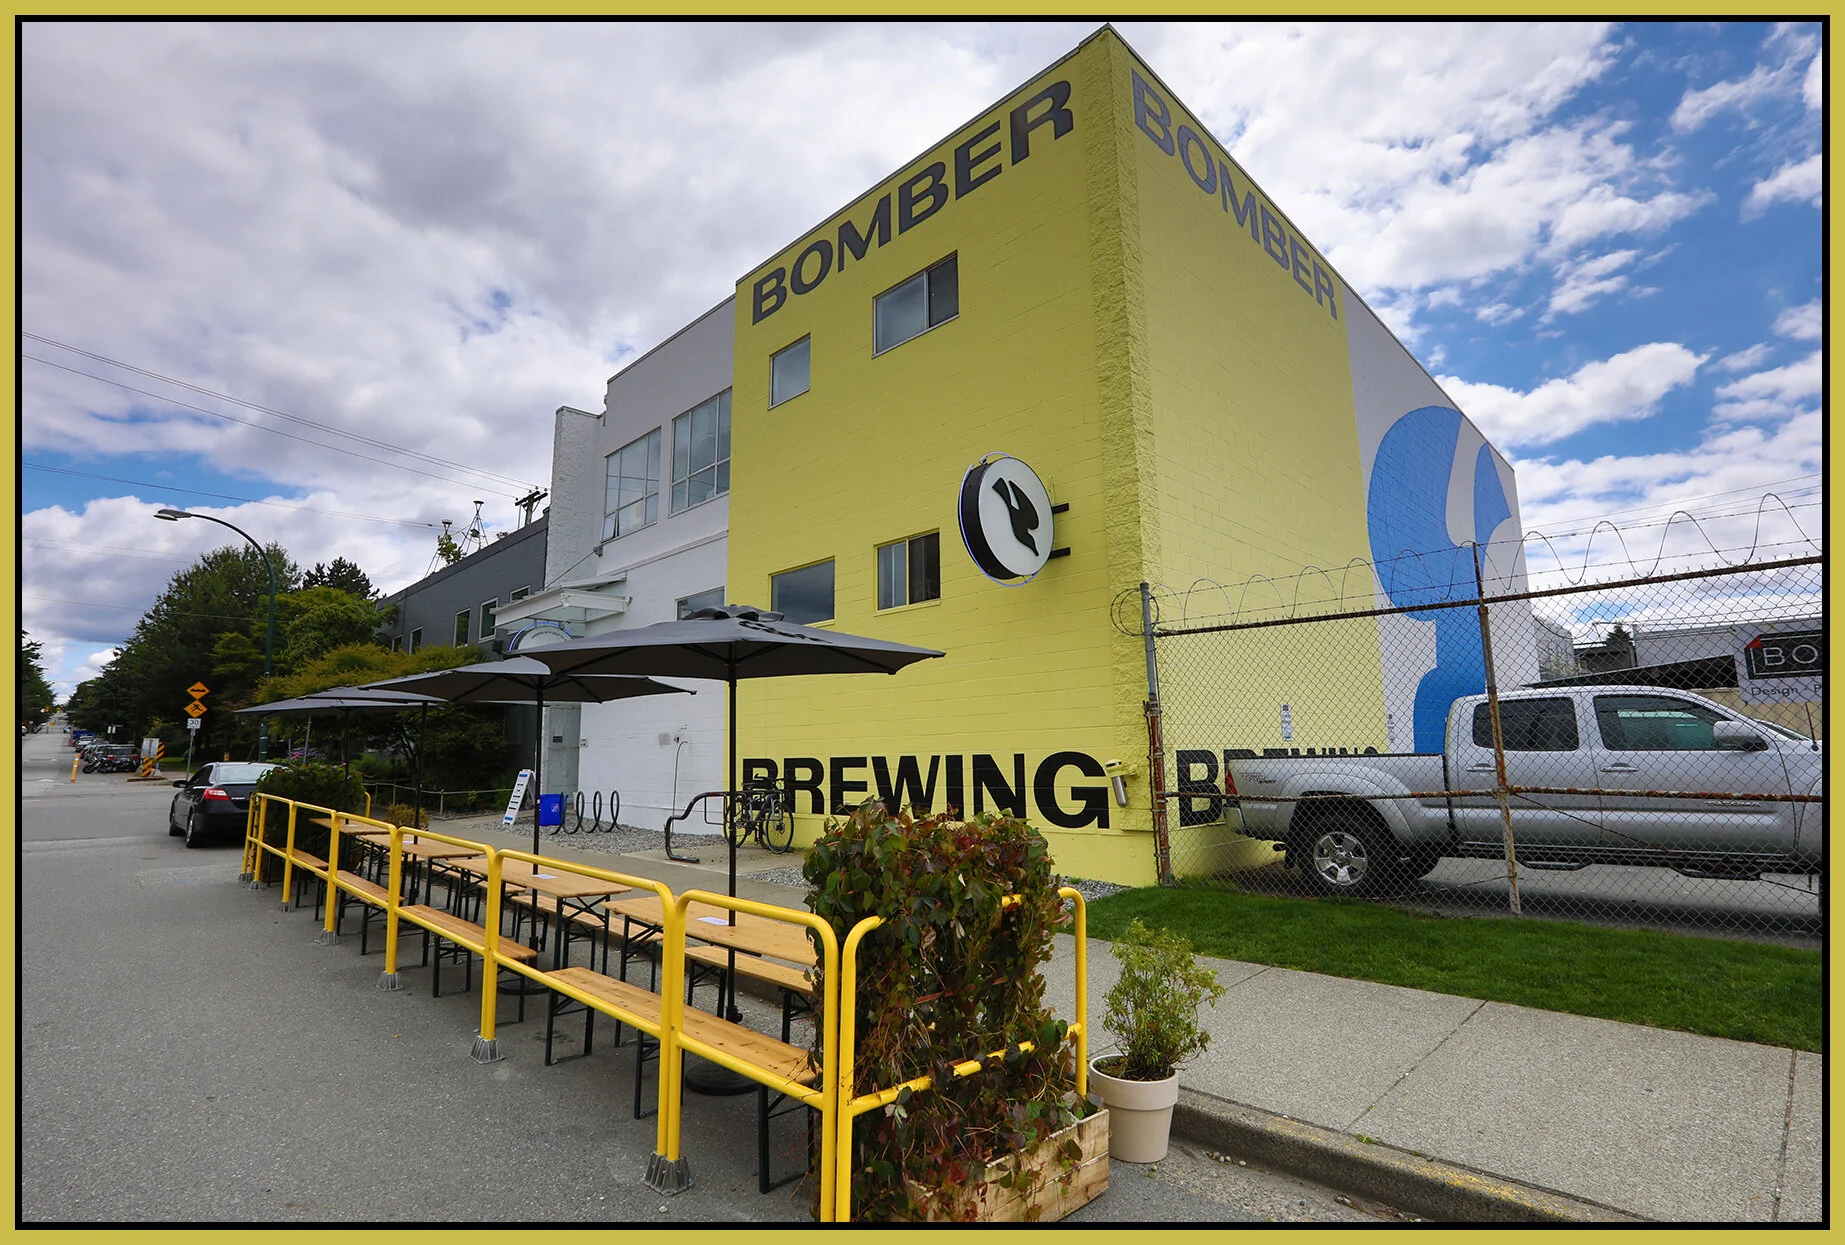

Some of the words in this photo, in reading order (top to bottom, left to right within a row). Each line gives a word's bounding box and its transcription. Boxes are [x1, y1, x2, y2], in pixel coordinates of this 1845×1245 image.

[752, 80, 1074, 326] BOMBER
[1131, 68, 1338, 320] BOMBER
[1751, 684, 1799, 697] Design
[1762, 644, 1818, 666] BO
[742, 751, 1110, 829] BREWING
